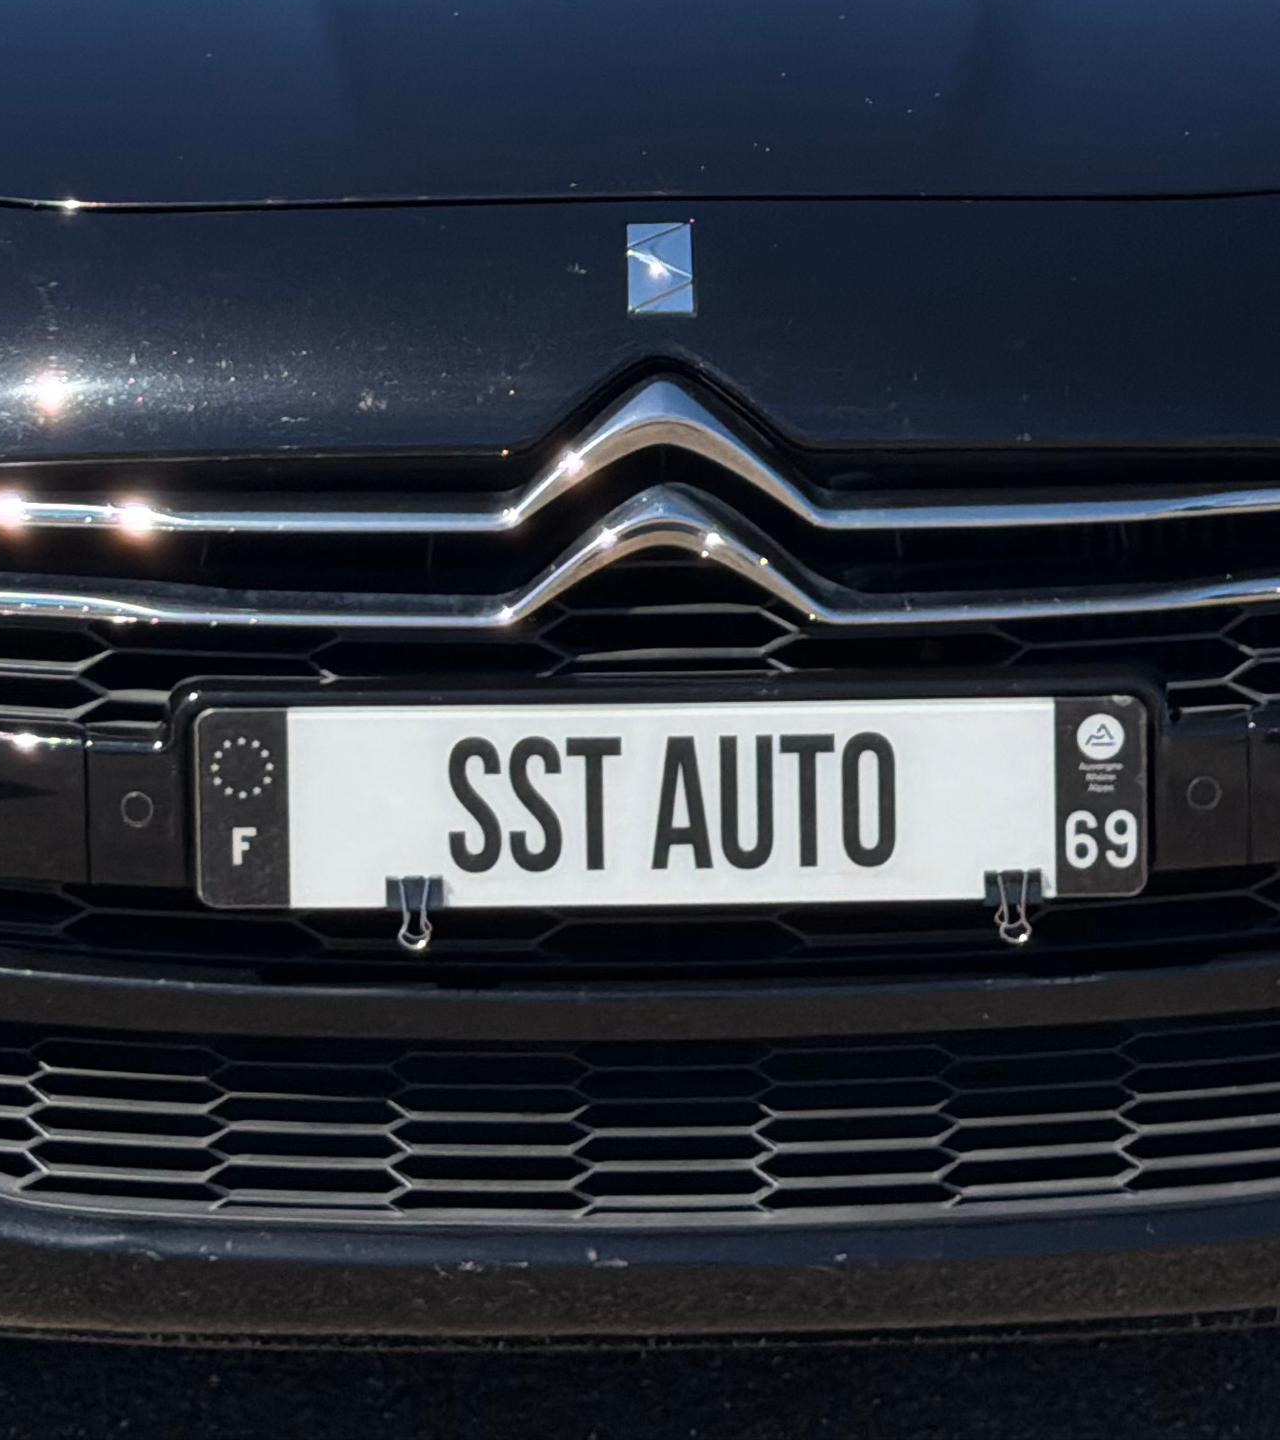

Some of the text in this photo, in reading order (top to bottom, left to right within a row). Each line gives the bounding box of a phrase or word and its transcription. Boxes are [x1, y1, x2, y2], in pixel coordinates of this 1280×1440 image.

[448, 732, 898, 872] SST AUTO
[233, 827, 256, 866] F
[1065, 809, 1138, 869] 69
